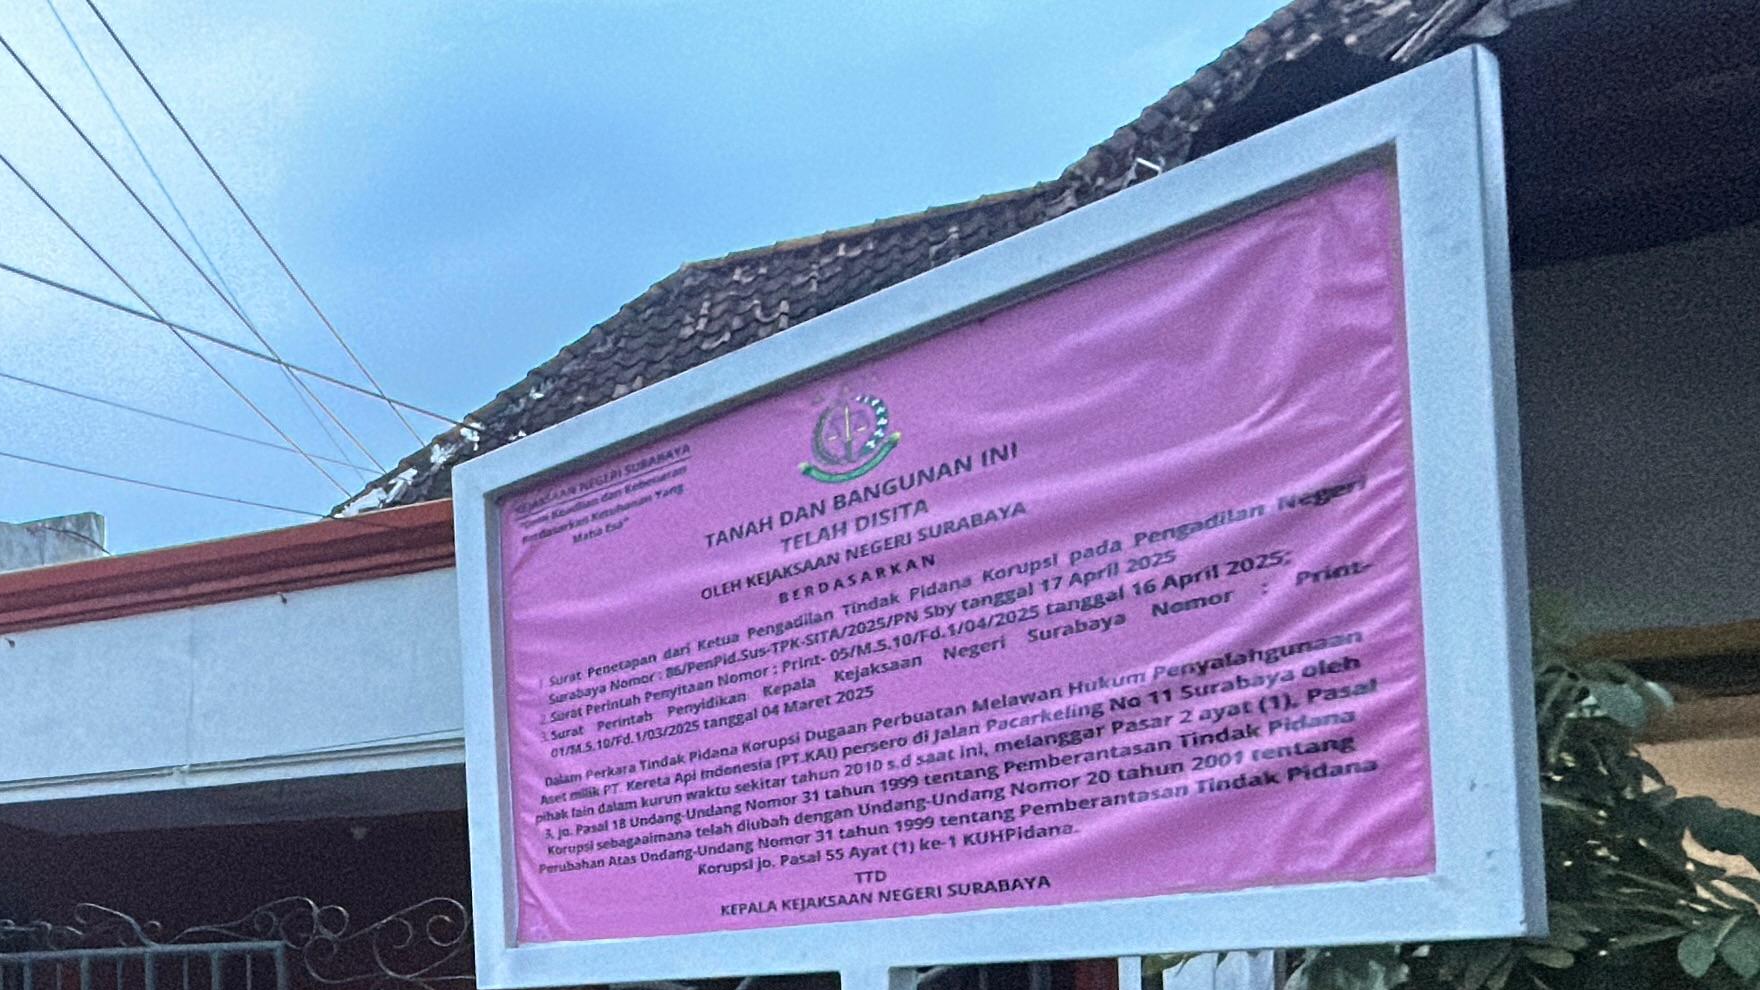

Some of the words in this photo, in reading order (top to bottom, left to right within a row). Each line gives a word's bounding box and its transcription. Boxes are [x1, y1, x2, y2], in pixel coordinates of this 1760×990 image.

[701, 579, 741, 600] OLEH
[746, 553, 839, 587] KEJAKSAAN
[846, 532, 912, 562] NEGERI
[918, 502, 1026, 542] SURABAYA
[706, 516, 773, 548] TANAH
[780, 500, 825, 526] DAN
[833, 456, 973, 510] BANGUNAN
[981, 442, 1018, 467] INI
[781, 523, 847, 552] TELAH
[855, 499, 928, 532] DISITA
[548, 683, 607, 705] Surabaya
[610, 673, 656, 692] Nomor
[924, 601, 956, 620] Sby
[962, 582, 1033, 611] tanggal
[1041, 576, 1063, 592] 17
[1069, 561, 1120, 588] April
[1126, 549, 1176, 573] 2025
[549, 670, 582, 686] Surat
[588, 653, 657, 678] Penetapan
[664, 643, 691, 660] dari
[698, 632, 740, 652] Ketua
[748, 609, 833, 640] Pengadilan
[842, 592, 900, 616] Tindak
[910, 576, 972, 600] Pidana
[982, 553, 1058, 583] Korupsi
[1070, 538, 1122, 567] pada
[1134, 504, 1265, 548] Pengadilan
[1277, 480, 1366, 510] Negeri
[550, 704, 583, 723] Surat
[586, 695, 641, 716] Perintah
[645, 678, 714, 703] Penyitaan
[717, 666, 768, 687] Nomor
[1046, 582, 1125, 616] tanggal
[1132, 578, 1156, 597] 16
[1162, 564, 1219, 591] April
[545, 772, 582, 787] Dalam
[586, 762, 637, 785] Perkara
[640, 754, 685, 772] Tindak
[689, 745, 738, 763] Pidana
[742, 732, 800, 756] Korupsi
[805, 721, 867, 744] Dugaan
[872, 704, 967, 731] Perbuatan
[972, 688, 1062, 714] Melawan
[1068, 672, 1145, 697] Hukum
[1153, 630, 1363, 681] Penyalahgunaan
[550, 725, 584, 741] Surat
[597, 711, 653, 733] Perintah
[667, 692, 747, 717] Penyidikan
[763, 677, 816, 697] Kepala
[834, 655, 923, 685] Kejaksaan
[943, 635, 1006, 661] Negeri
[1027, 613, 1126, 643] Surabaya
[1151, 590, 1234, 618] Nomor
[704, 711, 758, 730] tanggal
[762, 704, 779, 718] 04
[784, 695, 831, 714] Maret
[837, 685, 874, 704] 2025
[535, 810, 569, 826] pihak
[571, 804, 595, 820] lain
[598, 798, 638, 815] dalam
[641, 792, 683, 808] kurun
[686, 785, 731, 802] waktu
[734, 777, 786, 796] sekitar
[792, 768, 840, 785] tahun
[844, 759, 883, 778] 2010
[886, 755, 912, 771] s.d
[916, 749, 955, 765] saat
[960, 742, 989, 760] ini,
[994, 726, 1105, 753] melanggar
[1112, 713, 1173, 735] Pasar
[1180, 710, 1192, 724] 2
[1198, 700, 1252, 724] ayat
[1307, 678, 1378, 704] Pasal
[540, 792, 568, 806] Aset
[570, 786, 600, 802] milik
[626, 775, 671, 792] Kereta
[674, 767, 697, 786] Api
[700, 759, 772, 780] Indonesia
[842, 736, 908, 759] persero
[912, 727, 929, 744] di
[932, 721, 980, 745] Jalan
[986, 702, 1104, 732] Pacarkeling
[1109, 694, 1141, 712] No
[1148, 688, 1173, 705] 11
[1180, 670, 1295, 700] Surabaya
[1301, 656, 1361, 679] oleh
[576, 821, 609, 837] Pasal
[612, 817, 626, 831] 18
[630, 801, 742, 829] Undang-Undang
[745, 795, 797, 812] Nomor
[802, 790, 819, 804] 31
[825, 782, 875, 800] tahun
[880, 775, 918, 793] 1999
[924, 764, 1000, 787] tentang
[1004, 738, 1172, 775] Pemberantasan
[1177, 724, 1260, 748] Tindak
[1267, 710, 1356, 736] Pidana
[539, 856, 605, 875] Perubahan
[608, 853, 637, 868] Atas
[640, 838, 754, 863] Undang-Undang
[757, 833, 810, 850] Nomor
[815, 828, 833, 842] 31
[839, 821, 889, 840] tahun
[895, 815, 935, 833] 1999
[940, 804, 1015, 828] tentang
[1020, 782, 1189, 818] Pemberantasan
[1195, 770, 1281, 795] Tindak
[1287, 758, 1378, 782] Pidana
[547, 840, 594, 857] Korupsi
[696, 822, 733, 839] telah
[737, 815, 789, 833] diubah
[794, 807, 854, 829] dengan
[858, 784, 1006, 817] Undang-Undang
[1010, 775, 1080, 796] Nomor
[1086, 770, 1111, 786] 20
[1117, 760, 1184, 782] tahun
[1191, 750, 1243, 772] 2001
[1251, 736, 1357, 763] tentang
[698, 857, 754, 877] Korupsi
[757, 856, 776, 873] jo.
[780, 850, 821, 868] Pasal
[826, 849, 844, 863] 55
[848, 844, 888, 863] Ayat
[892, 840, 915, 857] (1)
[919, 833, 957, 851] ke-1
[720, 900, 777, 917] KEPALA
[782, 891, 873, 915] KEJAKSAAN
[879, 887, 942, 904] NEGERI
[947, 875, 1051, 898] SURABAYA
[854, 870, 888, 884] TTD
